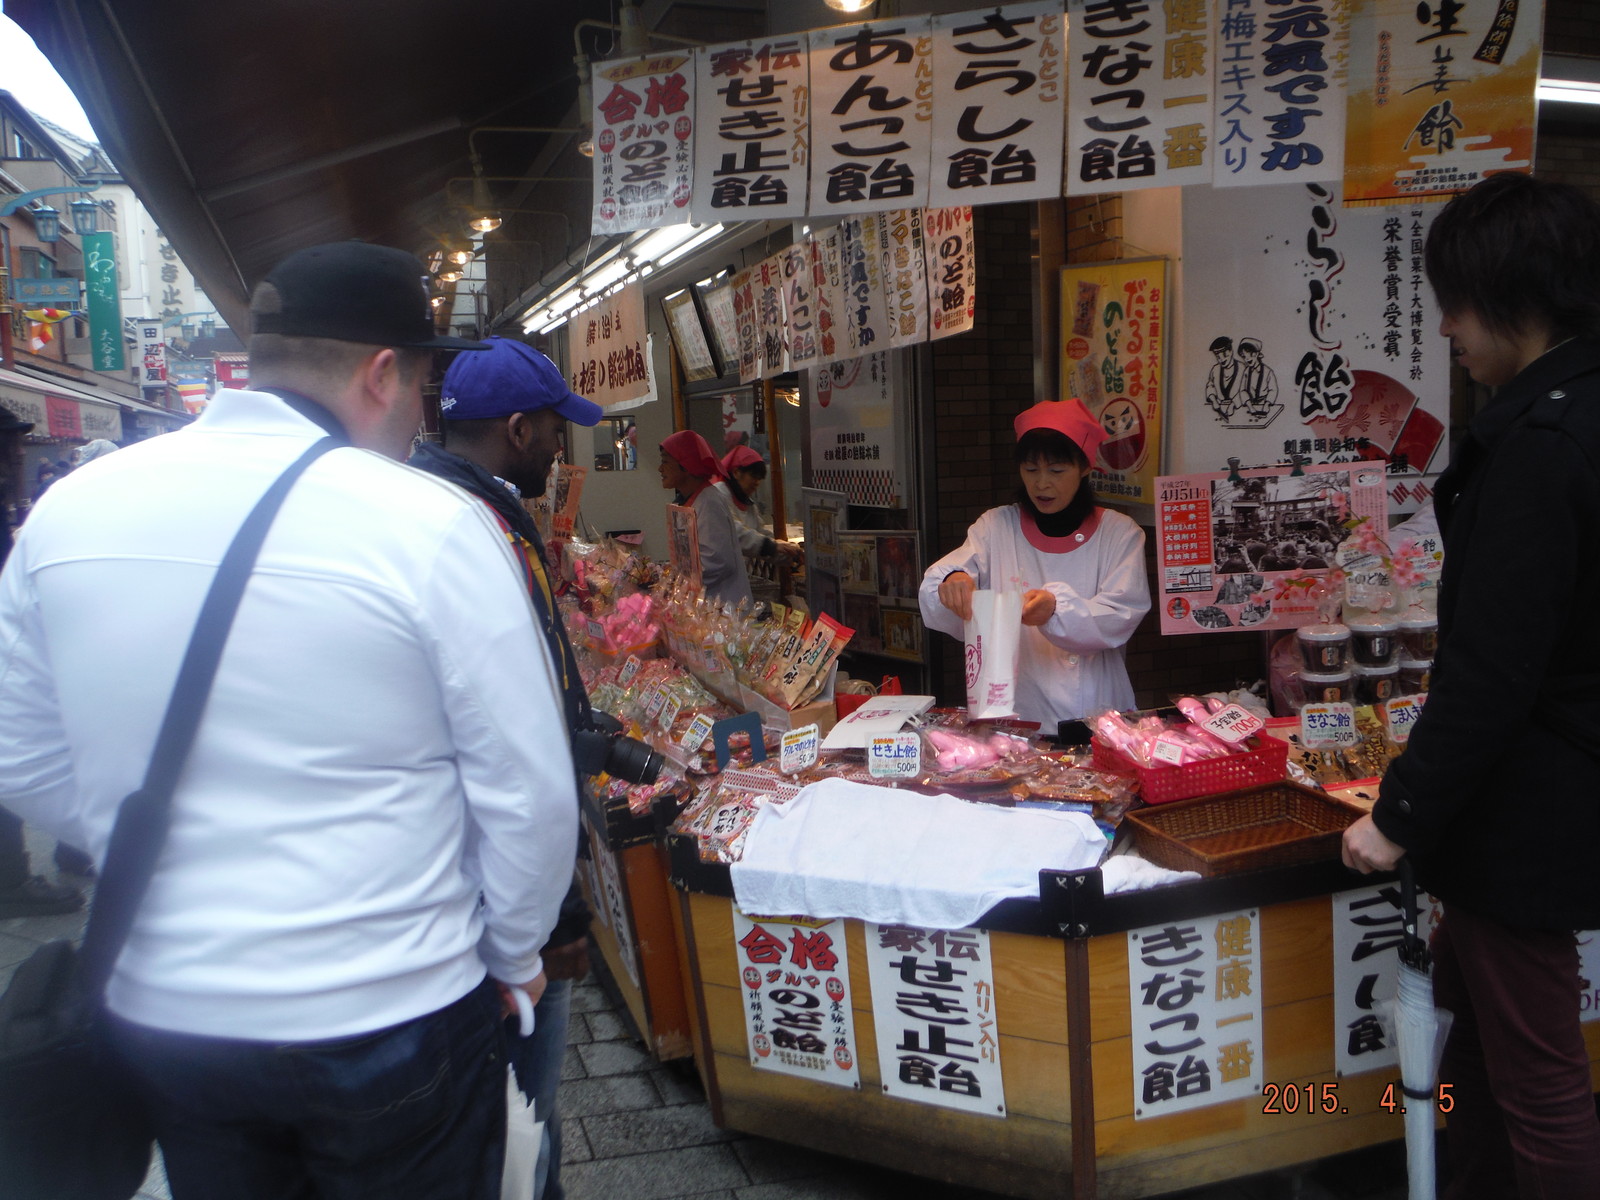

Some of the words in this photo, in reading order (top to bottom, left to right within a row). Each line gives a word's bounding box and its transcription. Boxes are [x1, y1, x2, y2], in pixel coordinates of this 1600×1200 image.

[598, 72, 690, 125] 合格
[710, 41, 801, 78] 家伝
[947, 9, 1038, 190] さらし飴
[1079, 0, 1156, 182] きなこ飴
[1163, 0, 1207, 170] 健康一番
[1261, 0, 1330, 171] 元気ですか
[710, 75, 790, 209] せき止飴
[826, 28, 914, 204] あんこ飴
[784, 250, 816, 361] あんこ飴
[940, 235, 965, 312] のど飴
[1382, 216, 1403, 358] 栄誉賞受賞
[1102, 301, 1124, 394] のど飴
[1124, 279, 1148, 397] だるま
[872, 743, 917, 759] せき止飴
[1211, 711, 1243, 730] 子宝飴
[1307, 713, 1351, 729] きなこ飴
[1335, 732, 1354, 743] 500円
[897, 762, 917, 773] 500円
[739, 923, 839, 971] 合格
[765, 968, 820, 989] ダルマ
[877, 924, 981, 962] 家伝
[768, 988, 828, 1055] のど飴
[889, 955, 982, 1098] せき止飴
[974, 980, 997, 1063] カリン入り
[1140, 926, 1212, 1105] きなこ飴
[1214, 915, 1255, 1084] 健康一番
